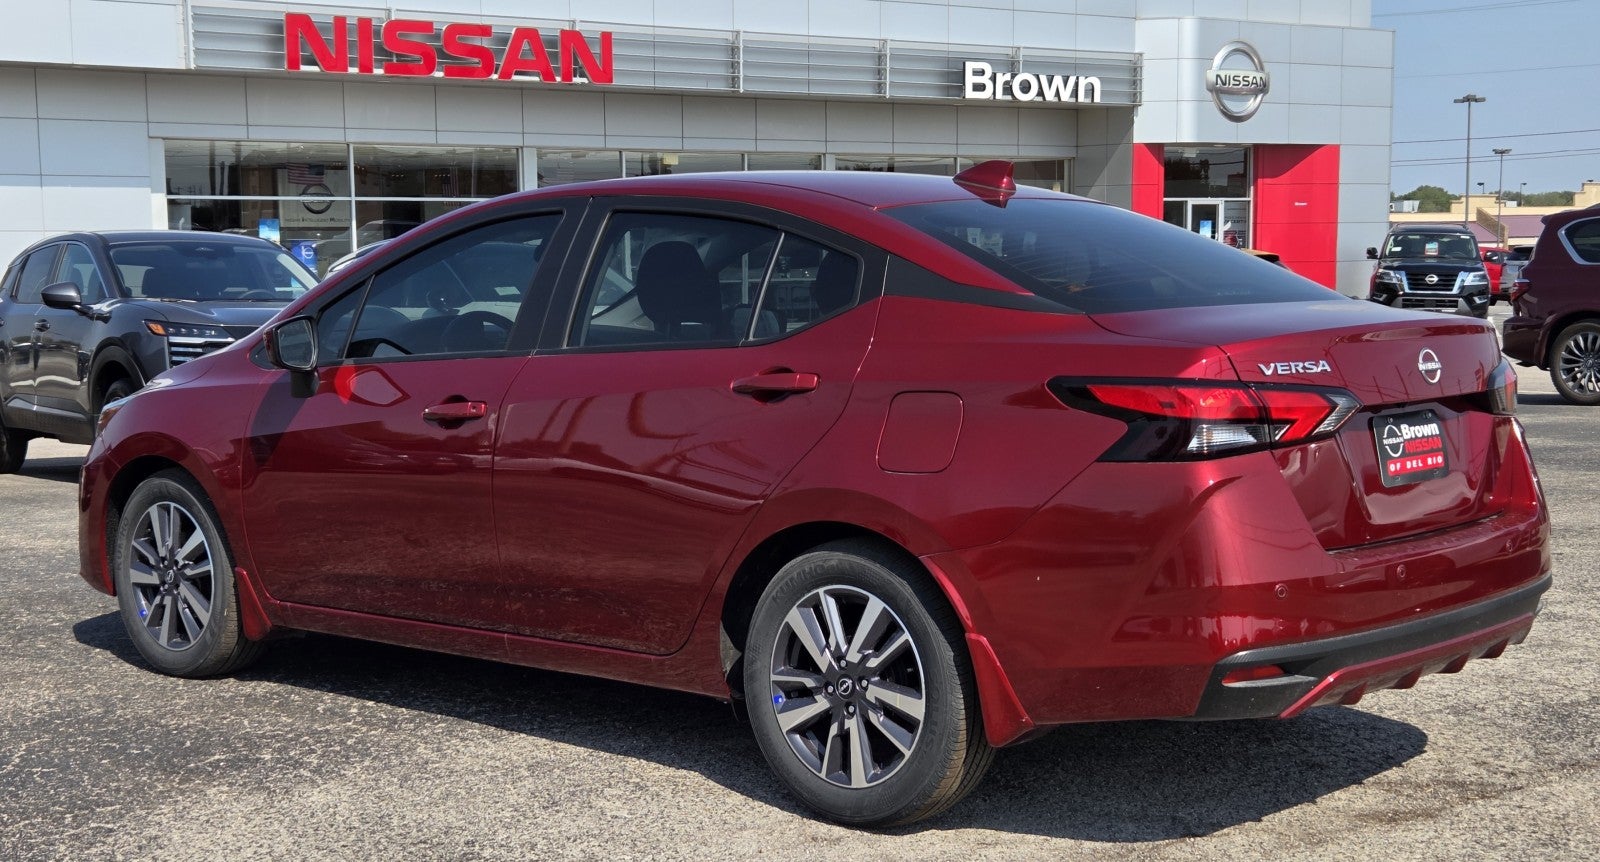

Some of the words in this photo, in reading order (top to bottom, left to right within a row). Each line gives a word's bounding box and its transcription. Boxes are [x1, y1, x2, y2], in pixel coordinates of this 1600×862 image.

[285, 12, 614, 85] NISSAN
[963, 61, 1101, 103] Brown
[1215, 73, 1267, 89] NISSAN
[1257, 360, 1332, 376] VERSA
[1418, 361, 1442, 371] NISSAN
[1400, 422, 1440, 440] Brown
[1382, 437, 1405, 445] NISSAN
[1404, 436, 1443, 453] NISSAN
[1389, 463, 1402, 471] OF
[1406, 459, 1423, 469] DEL
[1427, 456, 1443, 465] RIO
